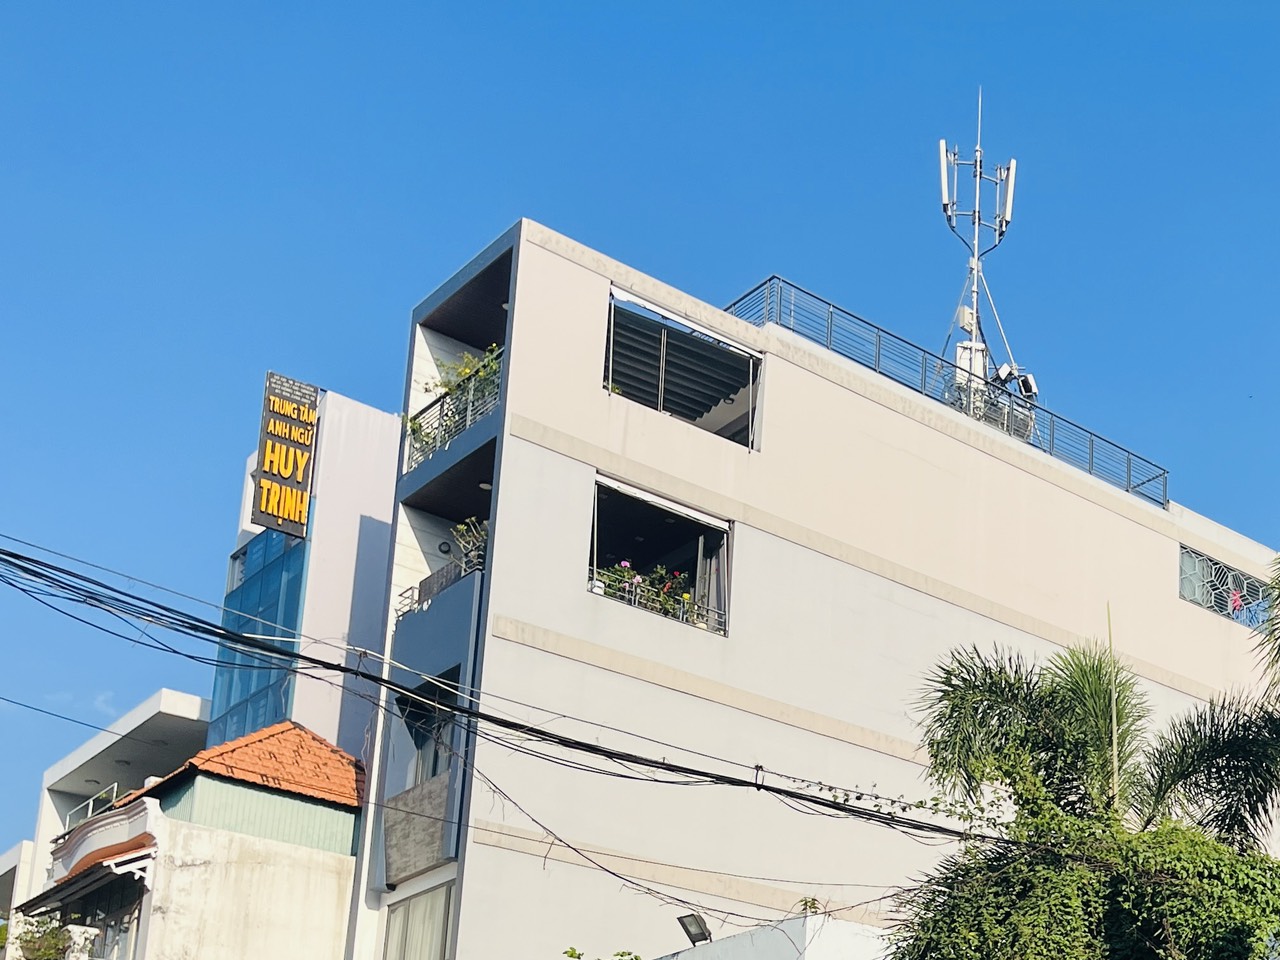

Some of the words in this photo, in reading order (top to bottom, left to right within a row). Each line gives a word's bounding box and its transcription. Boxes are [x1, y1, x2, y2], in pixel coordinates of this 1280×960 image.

[267, 418, 289, 439] ANH
[269, 396, 298, 419] TRUNG
[299, 402, 316, 425] TÂM
[262, 440, 310, 483] HUY
[260, 478, 308, 526] TRỊNH
